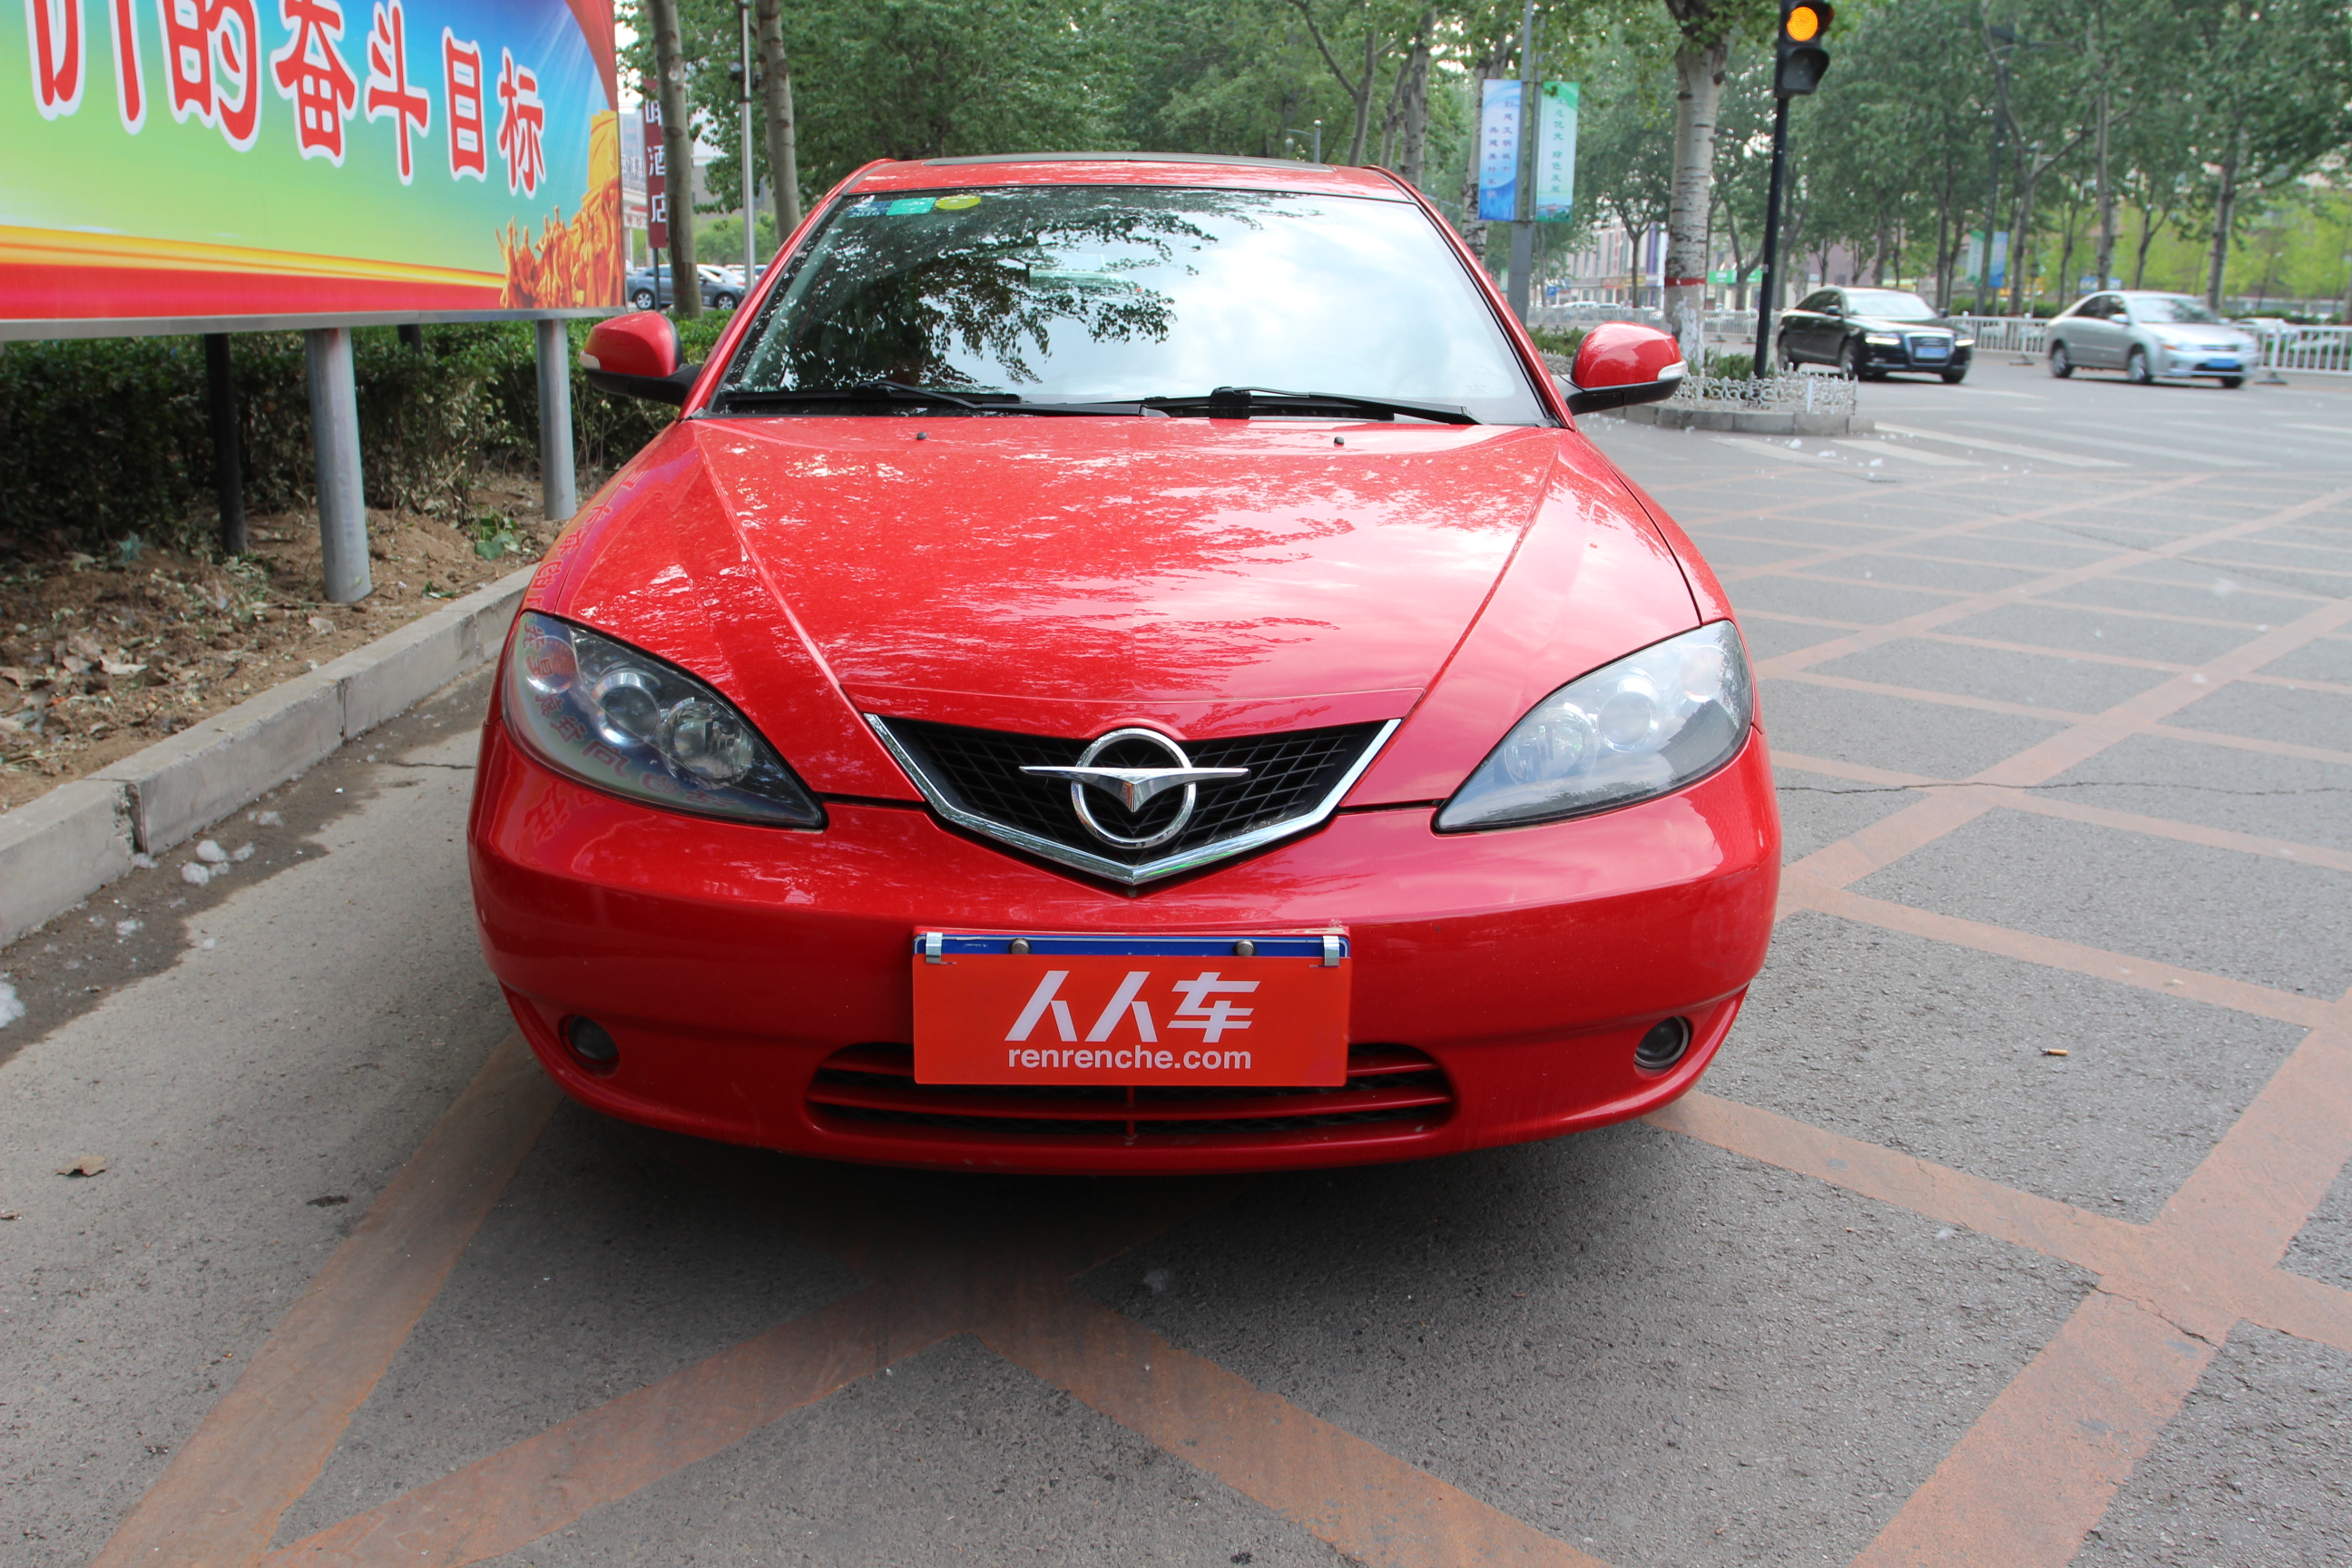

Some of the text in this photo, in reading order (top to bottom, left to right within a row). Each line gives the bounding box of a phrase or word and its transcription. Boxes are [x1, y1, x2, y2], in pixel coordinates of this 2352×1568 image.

[1004, 970, 1261, 1043] 人人车
[1008, 1044, 1251, 1069] renrenche.com
